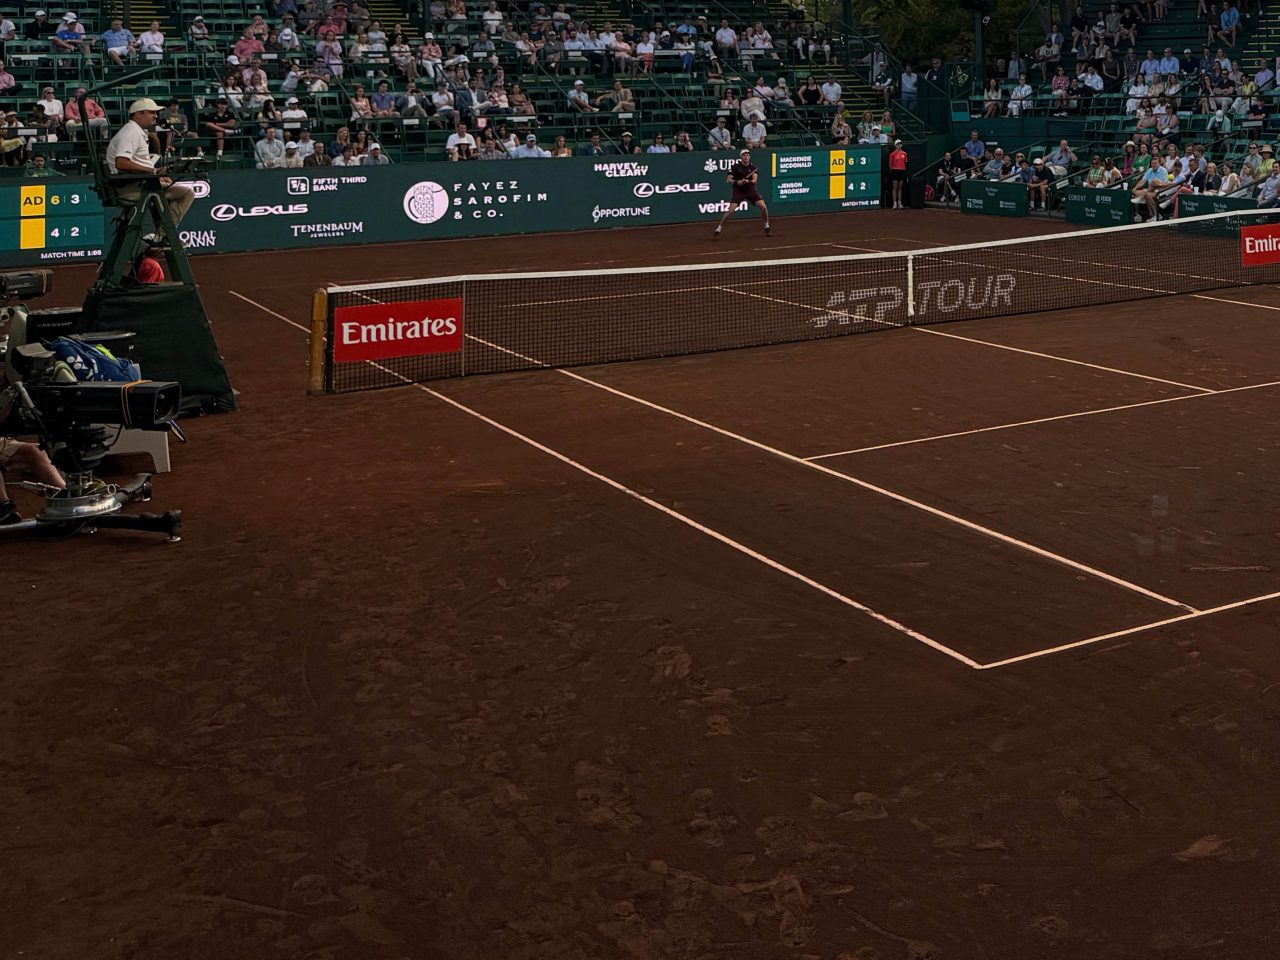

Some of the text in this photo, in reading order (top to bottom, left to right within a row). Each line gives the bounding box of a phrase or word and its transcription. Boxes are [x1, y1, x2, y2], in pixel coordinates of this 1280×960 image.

[848, 157, 854, 165] 6
[860, 156, 867, 165] 3
[605, 168, 648, 177] CLEARY
[341, 176, 367, 184] THIRD
[312, 184, 338, 192] BANK
[453, 180, 519, 192] FAYEZ
[655, 182, 710, 194] LEXUS
[780, 187, 809, 195] BROOKSBY
[847, 182, 866, 191] 4 2
[23, 194, 80, 206] AD 6 3
[453, 193, 548, 206] SAROFIM
[238, 204, 309, 217] LEXUS
[454, 209, 504, 220] & CO.
[592, 205, 651, 220] OPPORTUNE
[50, 227, 80, 237] 4 2
[291, 221, 364, 237] TENENBAUM
[41, 251, 67, 260] MATCH
[68, 250, 85, 258] TIME
[811, 273, 1017, 329] ATP TOUR
[342, 317, 457, 345] Emirates
